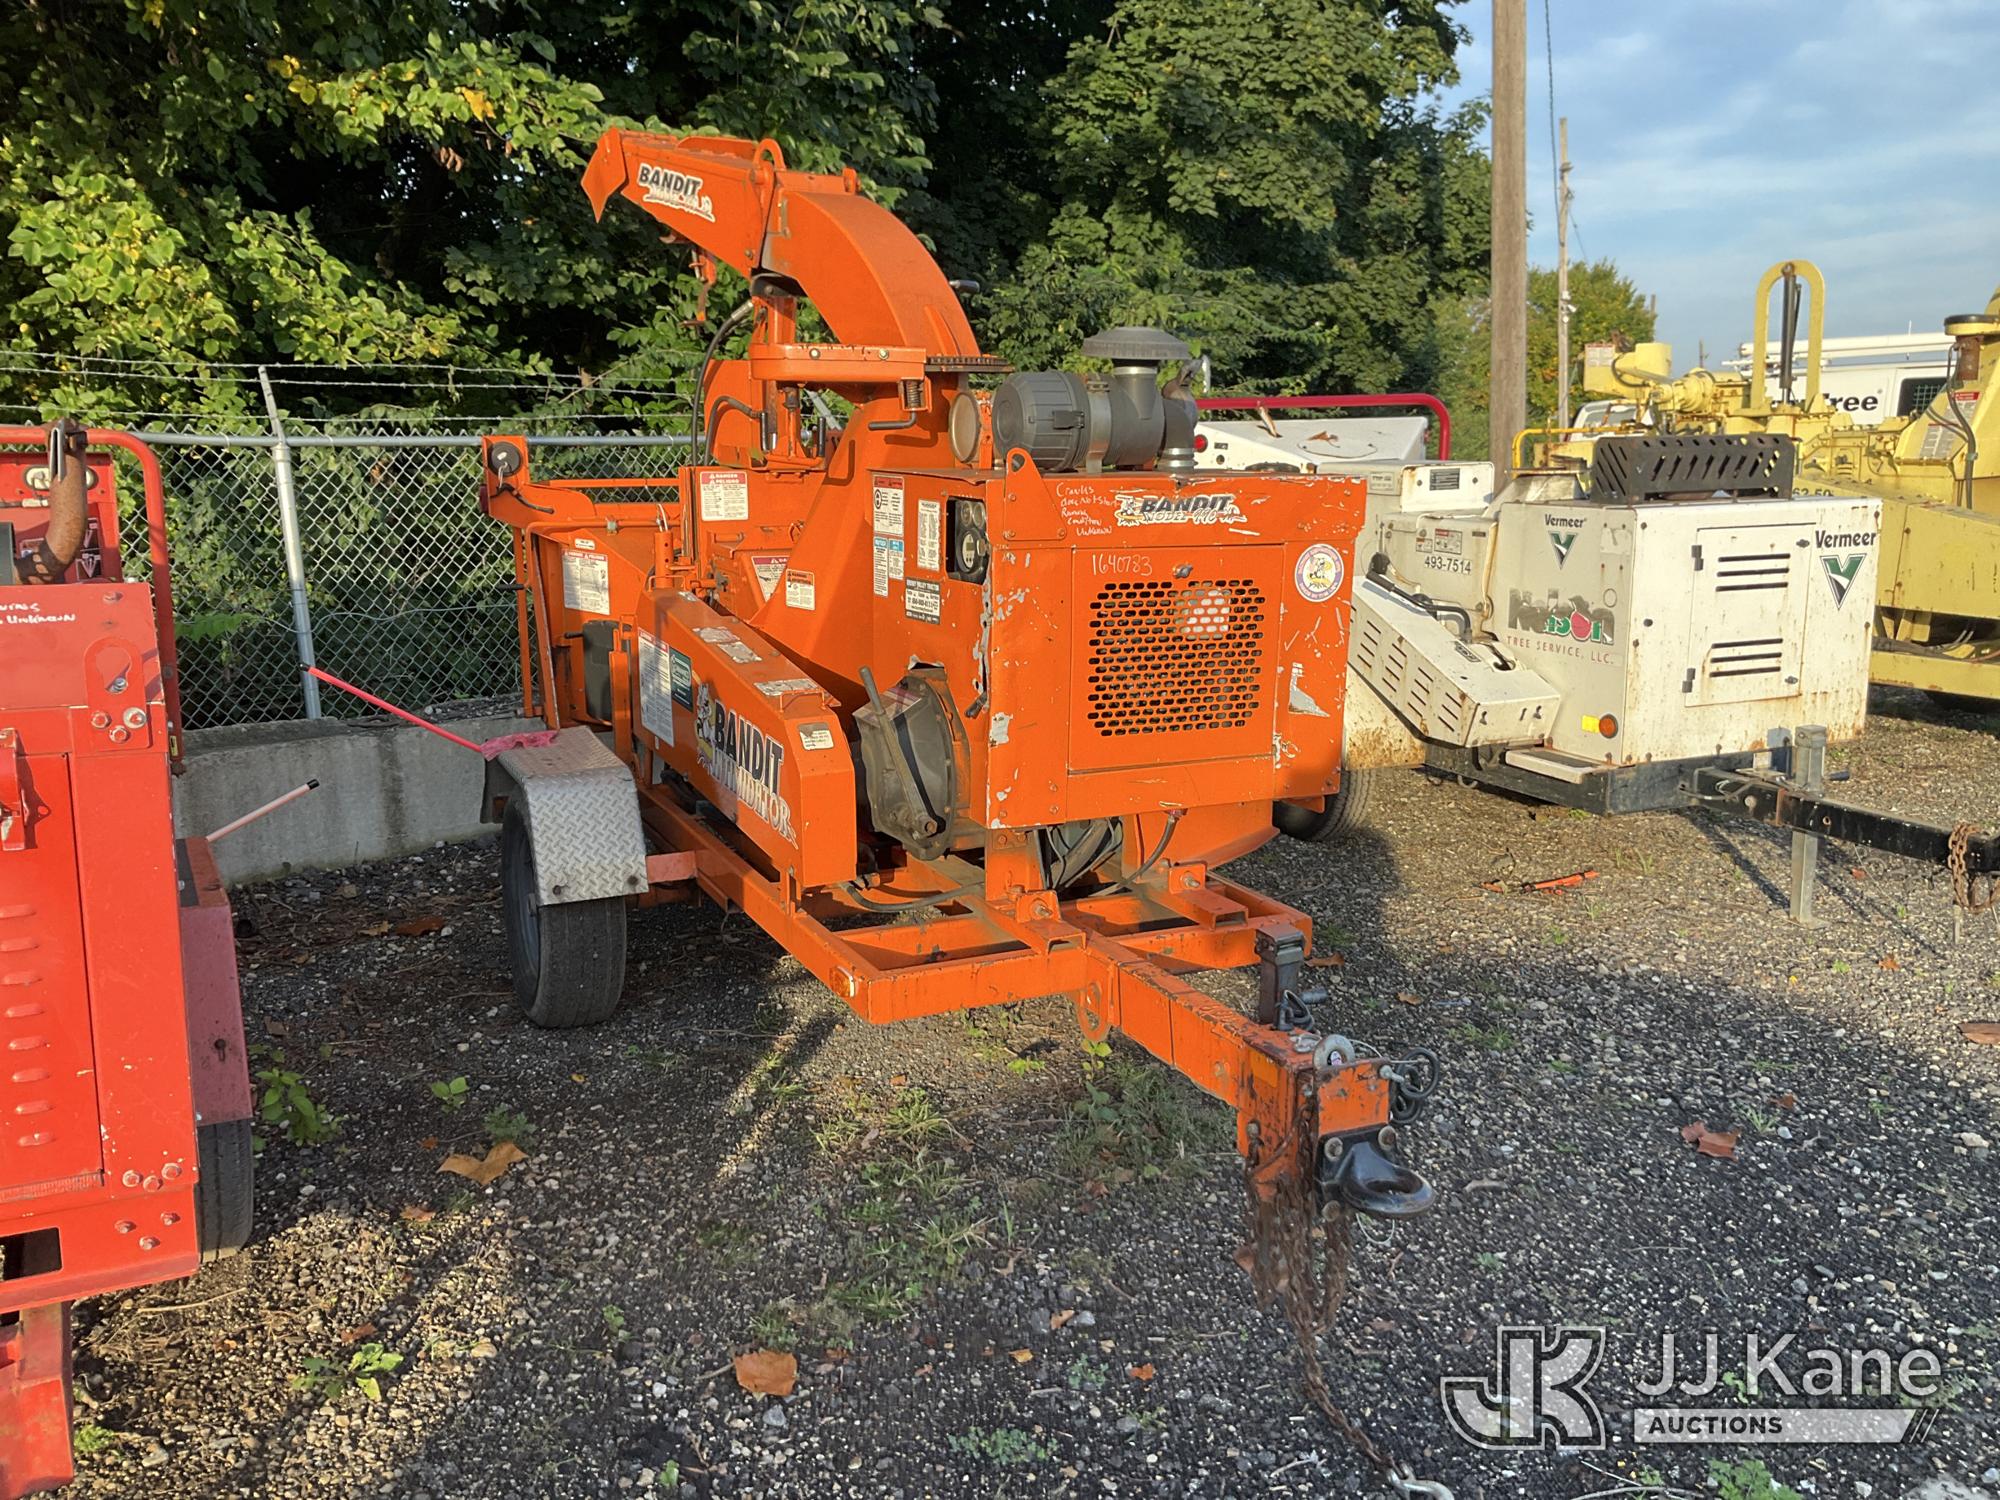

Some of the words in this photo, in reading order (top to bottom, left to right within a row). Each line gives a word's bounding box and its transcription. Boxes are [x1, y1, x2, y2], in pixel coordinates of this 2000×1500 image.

[639, 165, 702, 196] BANDIT
[1822, 393, 1879, 412] ree
[1140, 495, 1233, 513] BANDIT
[1544, 514, 1585, 529] Vermeer
[1815, 530, 1877, 549] Vermeer
[1092, 553, 1153, 577] 1640783
[1424, 556, 1472, 576] 493-7514
[1507, 636, 1530, 649] TREE
[1536, 639, 1584, 660] SERVICE,
[714, 699, 784, 797] BANDIT
